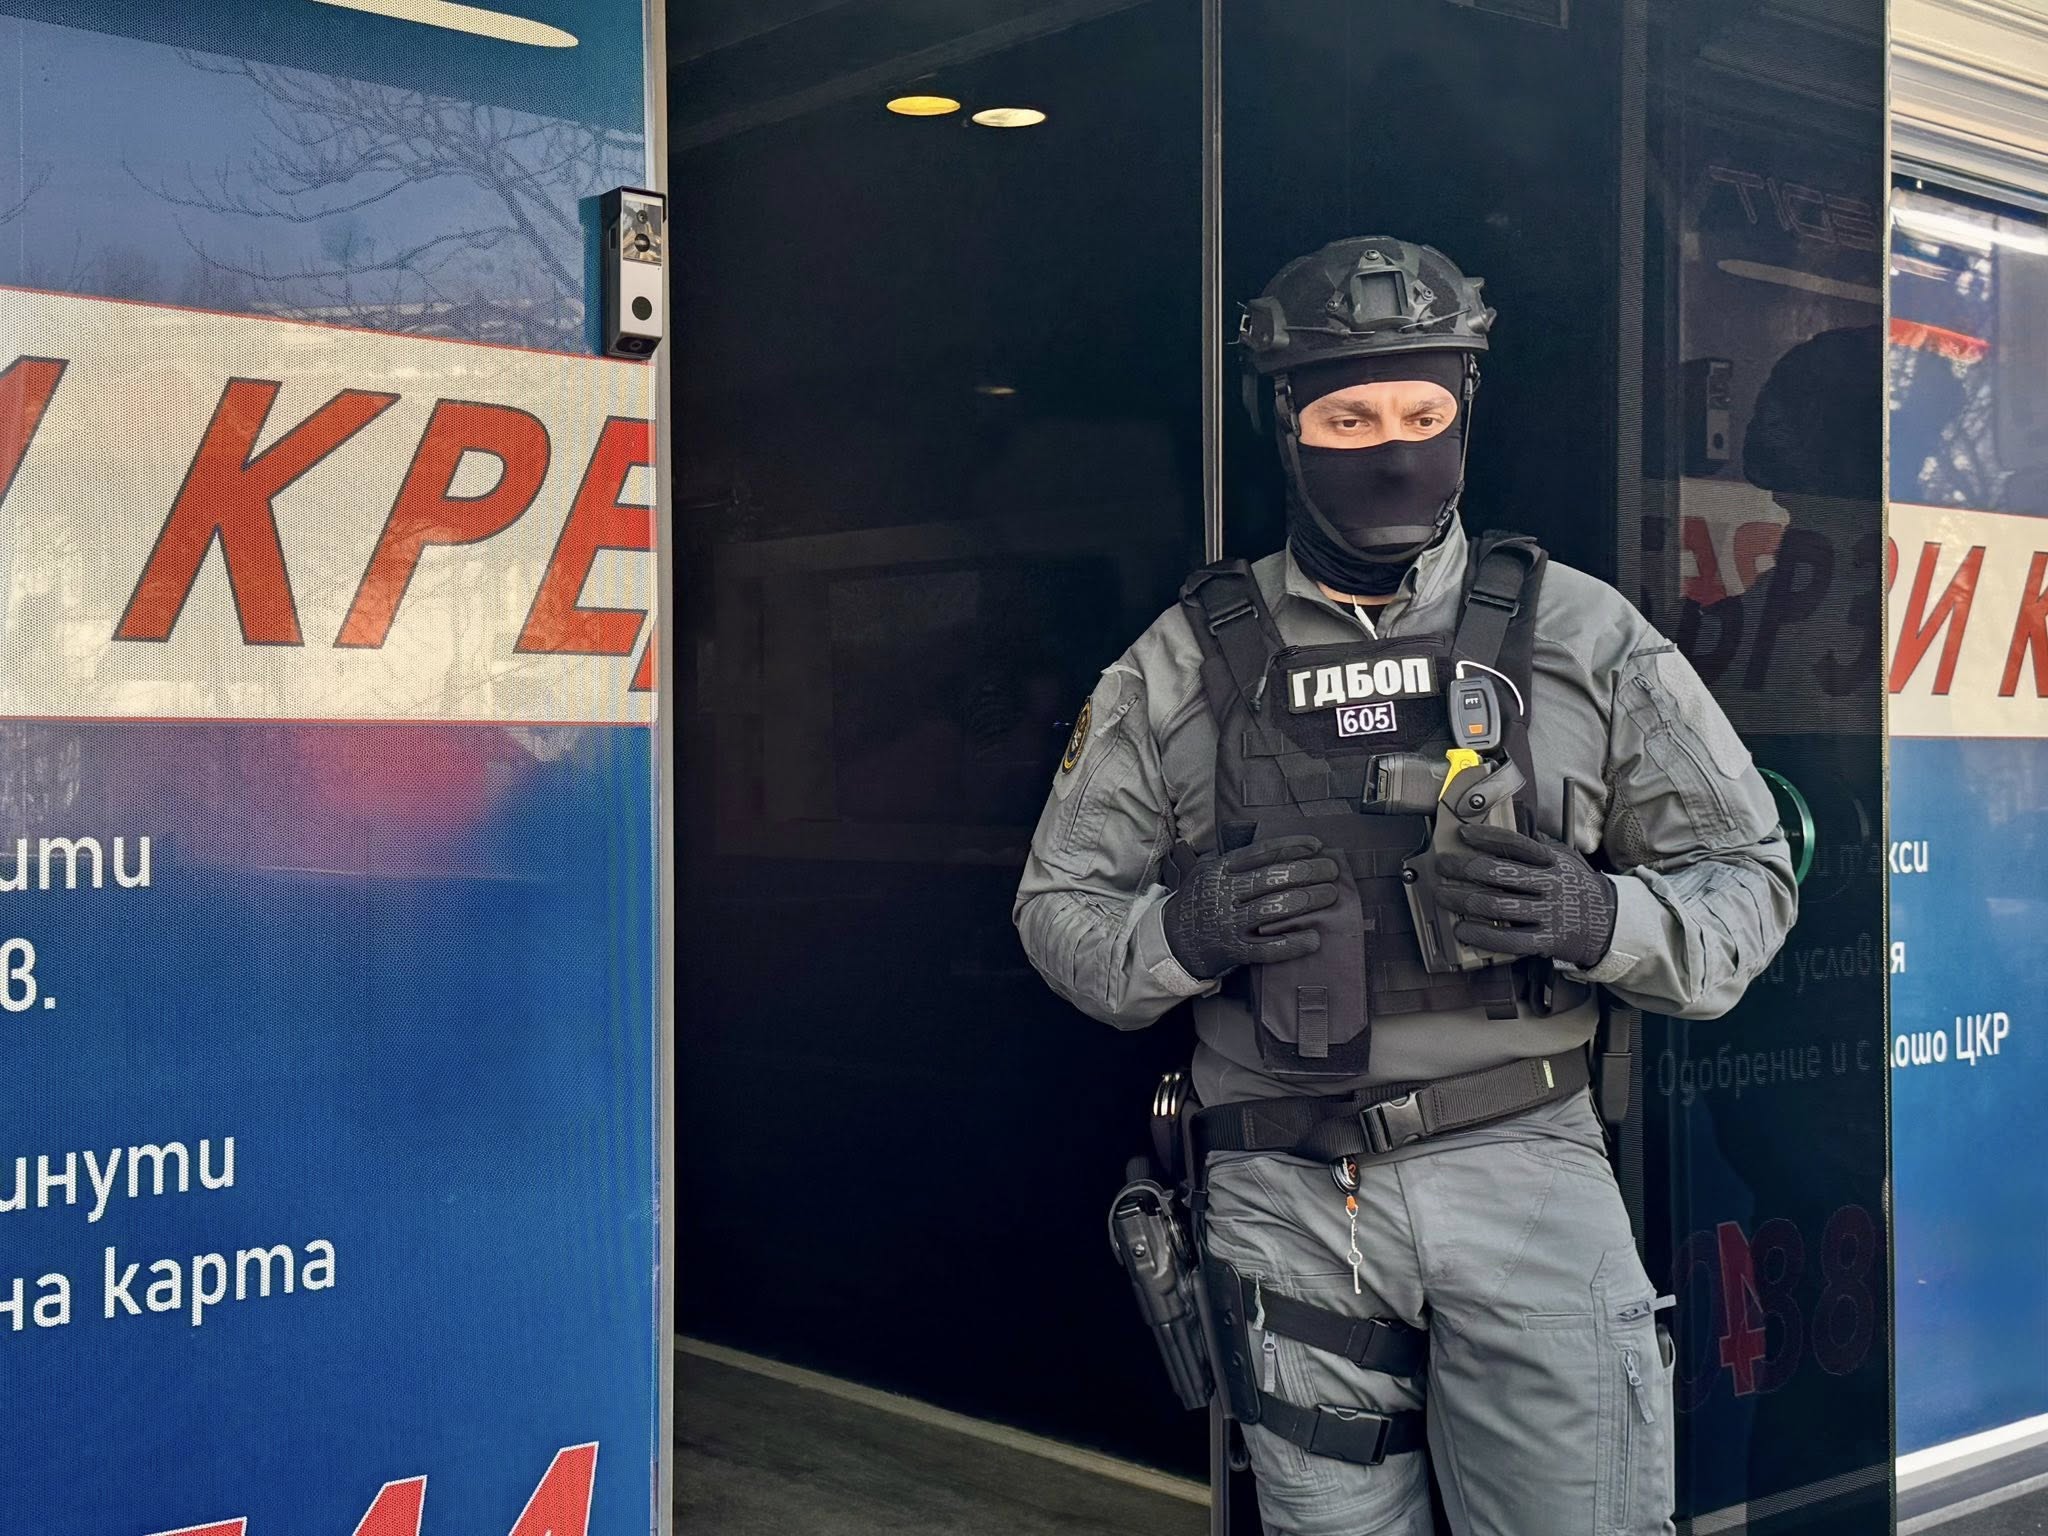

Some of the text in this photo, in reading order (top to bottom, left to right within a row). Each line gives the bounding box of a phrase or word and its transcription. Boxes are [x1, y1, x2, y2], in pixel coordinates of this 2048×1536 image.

[111, 377, 657, 692] КРЕ
[1291, 658, 1431, 707] ГДБОП
[1342, 707, 1391, 733] 605
[1657, 1039, 1823, 1107] Одобрение
[1890, 1030, 1947, 1068] ошо
[1955, 1011, 2009, 1066] ЦКР
[103, 1238, 337, 1327] карта
